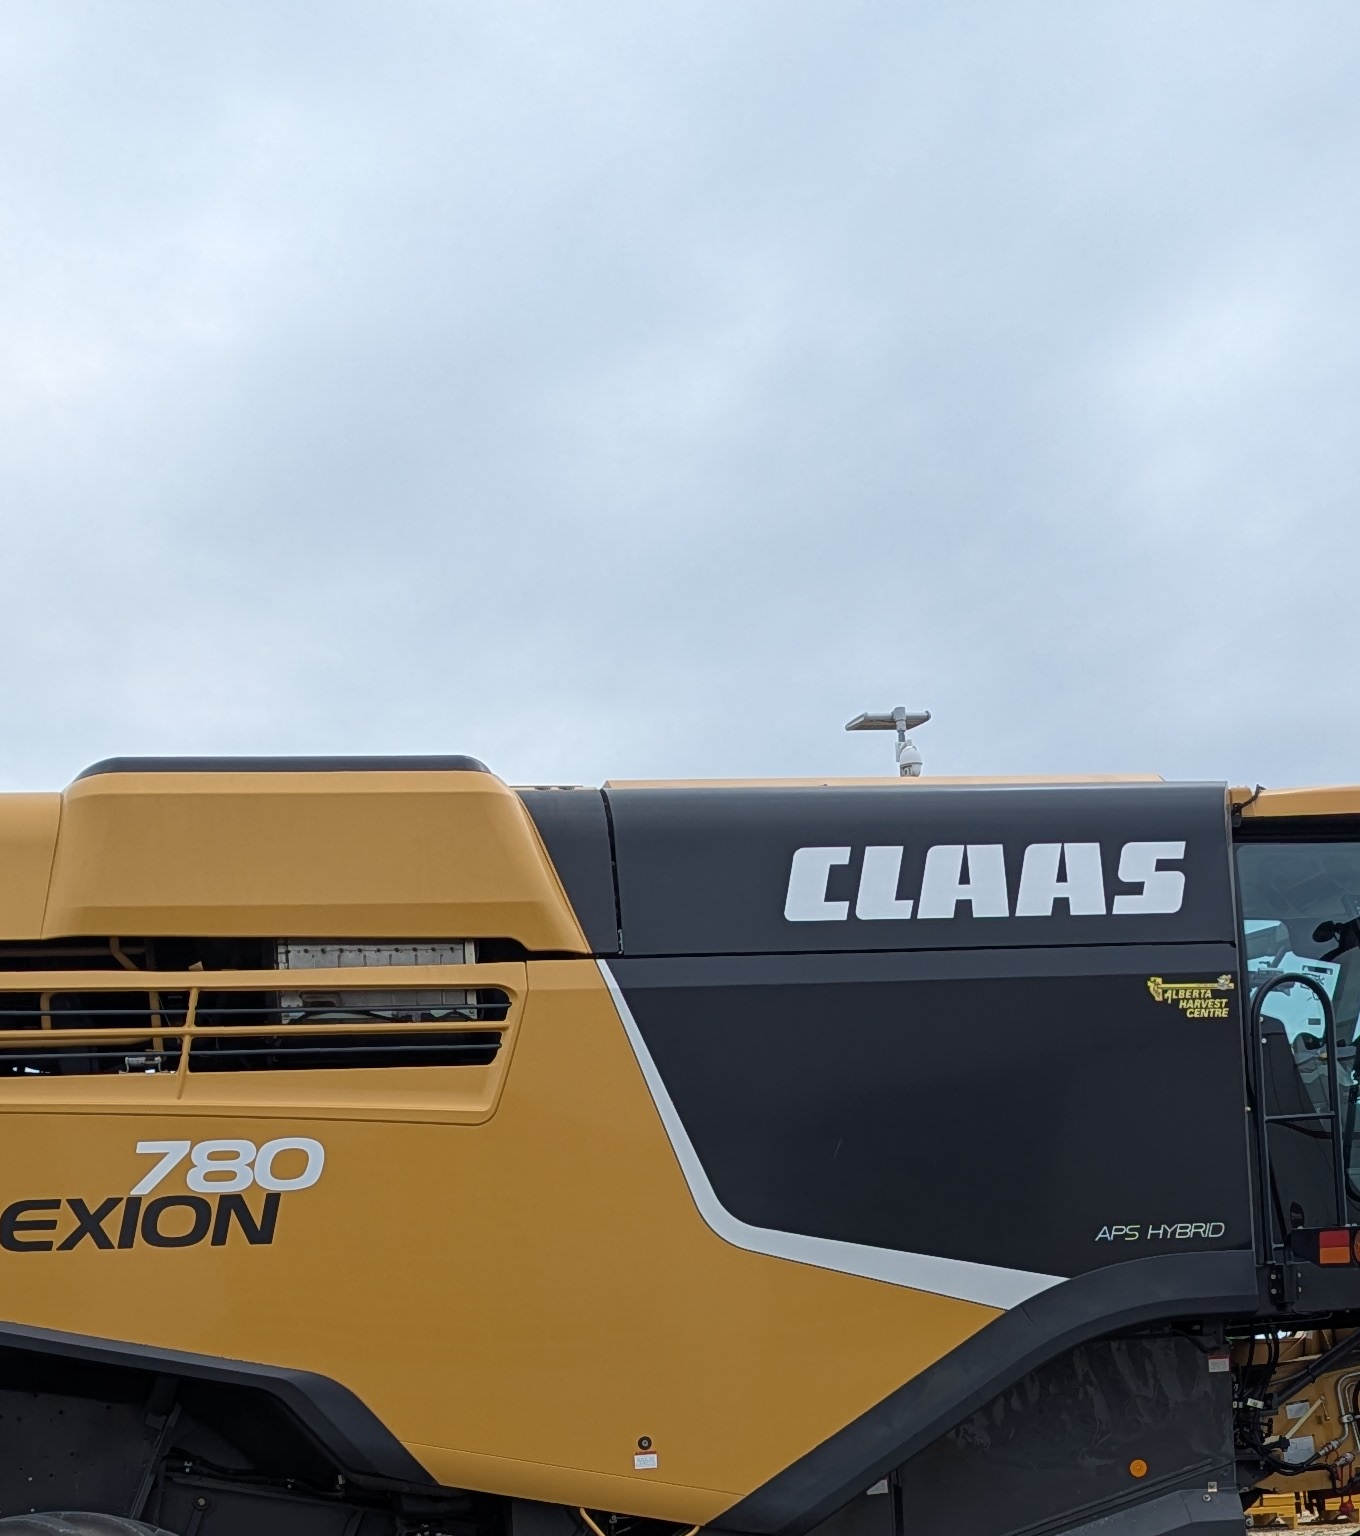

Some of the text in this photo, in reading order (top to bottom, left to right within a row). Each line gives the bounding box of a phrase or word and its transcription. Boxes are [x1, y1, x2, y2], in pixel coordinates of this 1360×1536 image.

[784, 841, 1187, 921] CLAAS
[1164, 989, 1212, 1004] ALBERTA
[1179, 999, 1228, 1009] HARVEST
[1186, 1008, 1229, 1017] CENTRE
[130, 1137, 325, 1196] 780
[1095, 1222, 1225, 1241] APS HYBRID
